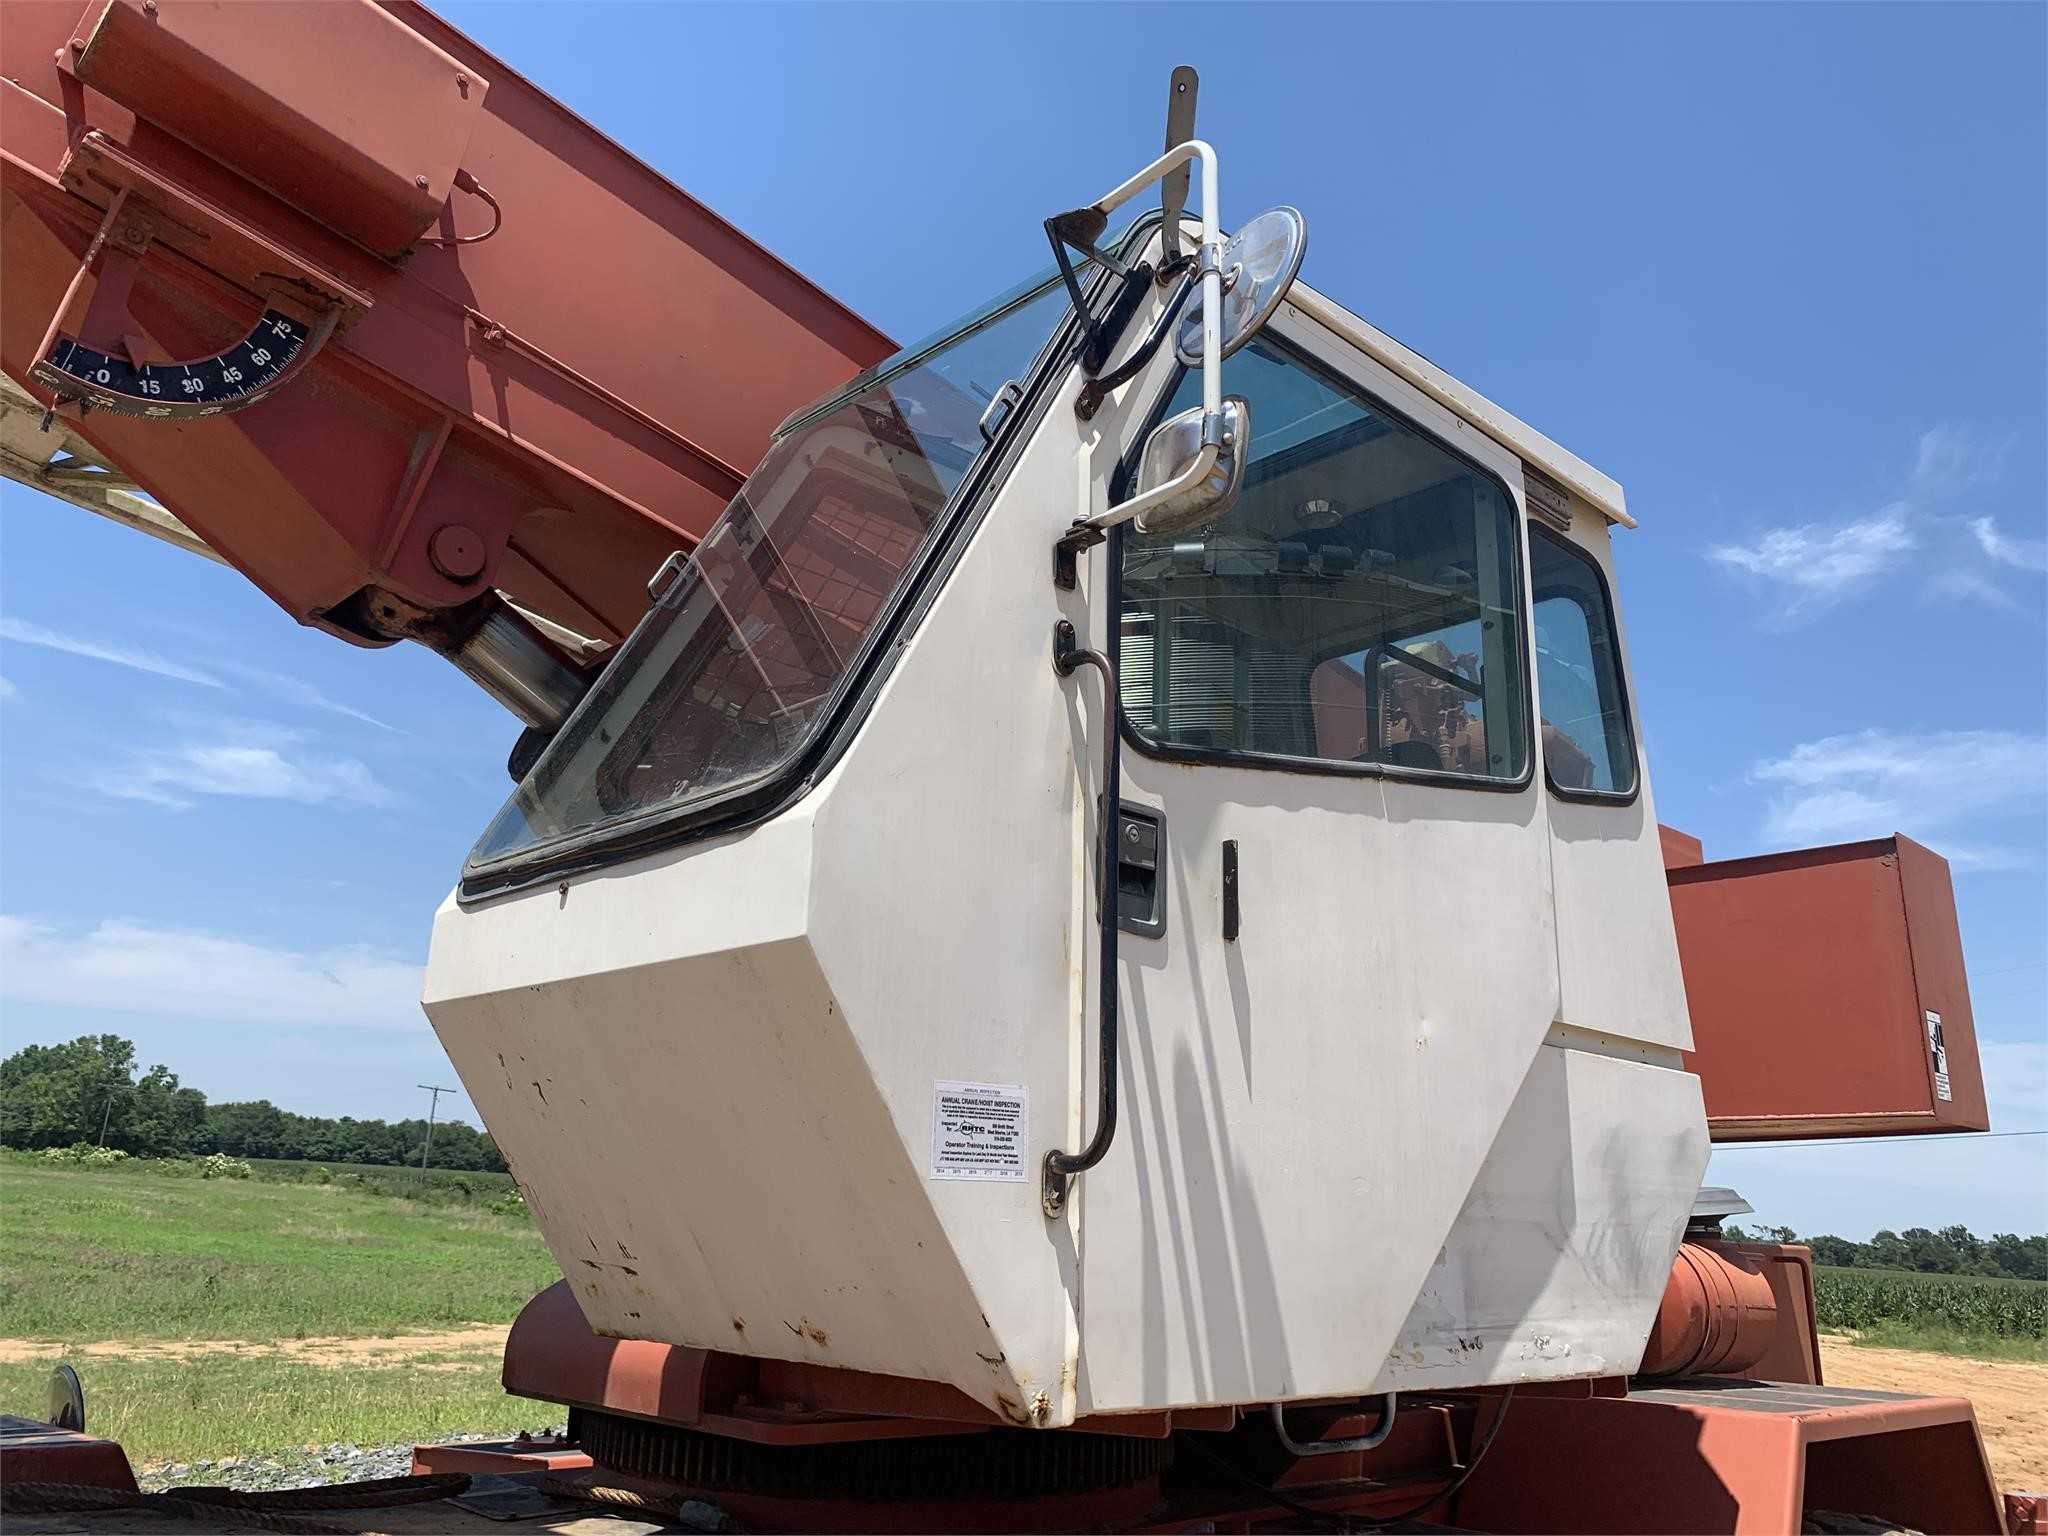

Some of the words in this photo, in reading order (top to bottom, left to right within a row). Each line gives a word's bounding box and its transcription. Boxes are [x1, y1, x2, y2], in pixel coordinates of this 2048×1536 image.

[96, 369, 111, 384] 0
[139, 378, 160, 395] 15
[181, 377, 205, 394] 30
[222, 367, 243, 384] 45
[251, 348, 272, 367] 60
[271, 320, 292, 339] 75
[941, 1096, 960, 1104] ANNUAL
[961, 1098, 993, 1107] CRANE/HOIST
[994, 1100, 1021, 1109] INSPECTION
[945, 1141, 966, 1149] Operator
[966, 1142, 984, 1150] Training
[989, 1143, 1015, 1151] Inspections
